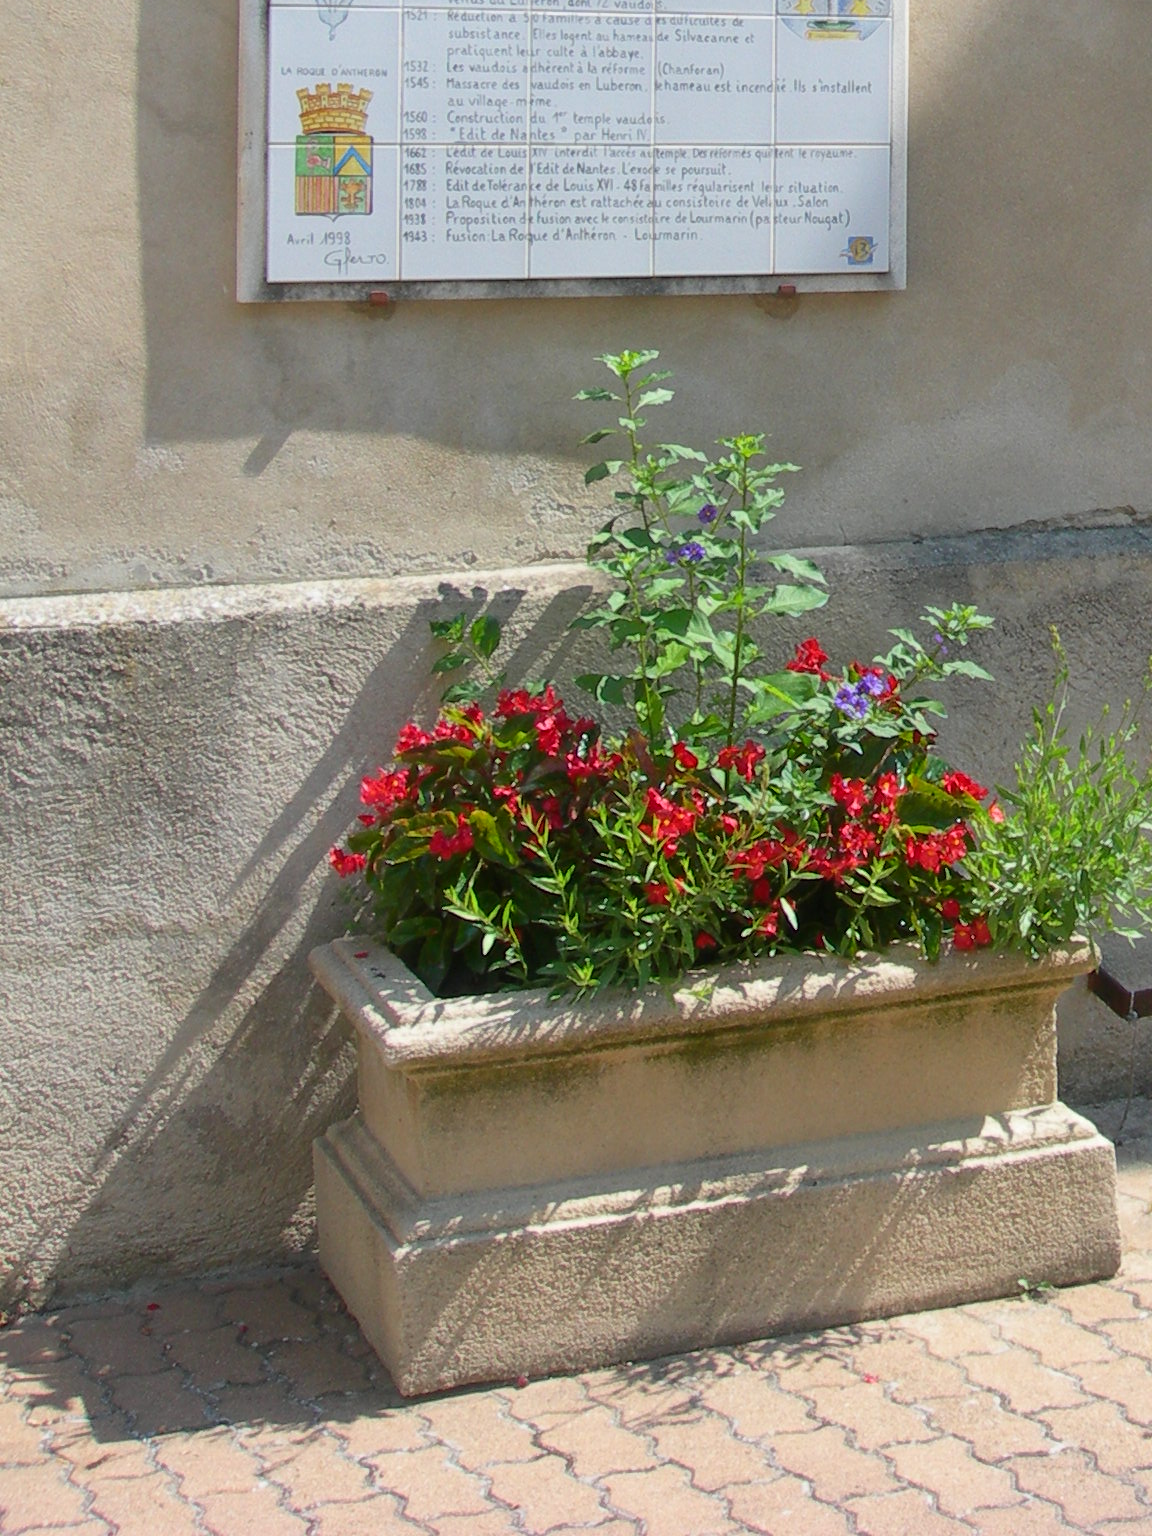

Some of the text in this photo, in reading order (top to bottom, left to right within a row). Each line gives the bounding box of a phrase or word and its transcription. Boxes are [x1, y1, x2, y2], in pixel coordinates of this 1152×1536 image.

[605, 16, 640, 26] cause
[731, 17, 745, 28] de
[560, 29, 592, 47] logent
[595, 33, 609, 43] au
[656, 30, 670, 43] de
[744, 32, 755, 44] et
[446, 45, 644, 62] pratiquent leur culte à l'abbaye.
[281, 65, 388, 77] LA ROQUE D'ANTHERON
[403, 60, 725, 80] 1532 Les vaudois adhèrent à la réforme (Chanforan)
[404, 77, 430, 89] 1545
[446, 77, 498, 90] Massacre
[501, 78, 520, 91] des
[530, 79, 574, 91] vaudois
[578, 81, 591, 91] en
[595, 77, 648, 93] Luberon.
[664, 79, 711, 93] hameau
[713, 81, 732, 93] est
[812, 78, 873, 95] s'installent
[447, 96, 464, 107] au
[403, 111, 428, 124] 1560
[446, 111, 523, 124] Construction
[530, 112, 546, 124] du
[573, 113, 612, 129] temple
[403, 127, 428, 141] 1598
[491, 127, 506, 141] de
[574, 130, 596, 144] par
[601, 129, 632, 142] Henri
[445, 147, 476, 159] L'édit
[480, 148, 493, 159] de
[497, 148, 528, 159] Louis
[531, 147, 547, 158] XIV
[554, 148, 598, 159] interdit
[603, 148, 636, 159] l'accès
[692, 148, 707, 159] Des
[709, 148, 752, 160] réformés
[798, 148, 807, 160] le
[810, 150, 857, 162] royaume.
[404, 163, 428, 175] 1685
[445, 161, 507, 176] Révocation
[509, 163, 524, 176] de
[529, 163, 560, 176] l'Edit
[562, 163, 575, 176] de
[621, 162, 661, 176] L'exode
[665, 166, 676, 176] se
[681, 163, 732, 181] poursuit.
[403, 178, 844, 197] 1788 Edit de Tolérance de Louis XVI 48 familles régularisent leur situation.
[404, 197, 427, 210] 1804
[445, 196, 460, 209] La
[461, 195, 497, 213] Roque
[501, 195, 566, 210] d'Anthéron
[570, 197, 587, 209] est
[591, 195, 644, 209] rattachée
[646, 200, 662, 209] au
[665, 197, 732, 209] consistoire
[736, 196, 749, 209] de
[403, 209, 851, 233] 1938 Proposition de fusion avec le consistoire de Lourmarin (pasteur Nougat)
[286, 230, 351, 246] Avril 1998
[403, 228, 703, 247] 1943 La Roque d'Anthéron Lourmarin.
